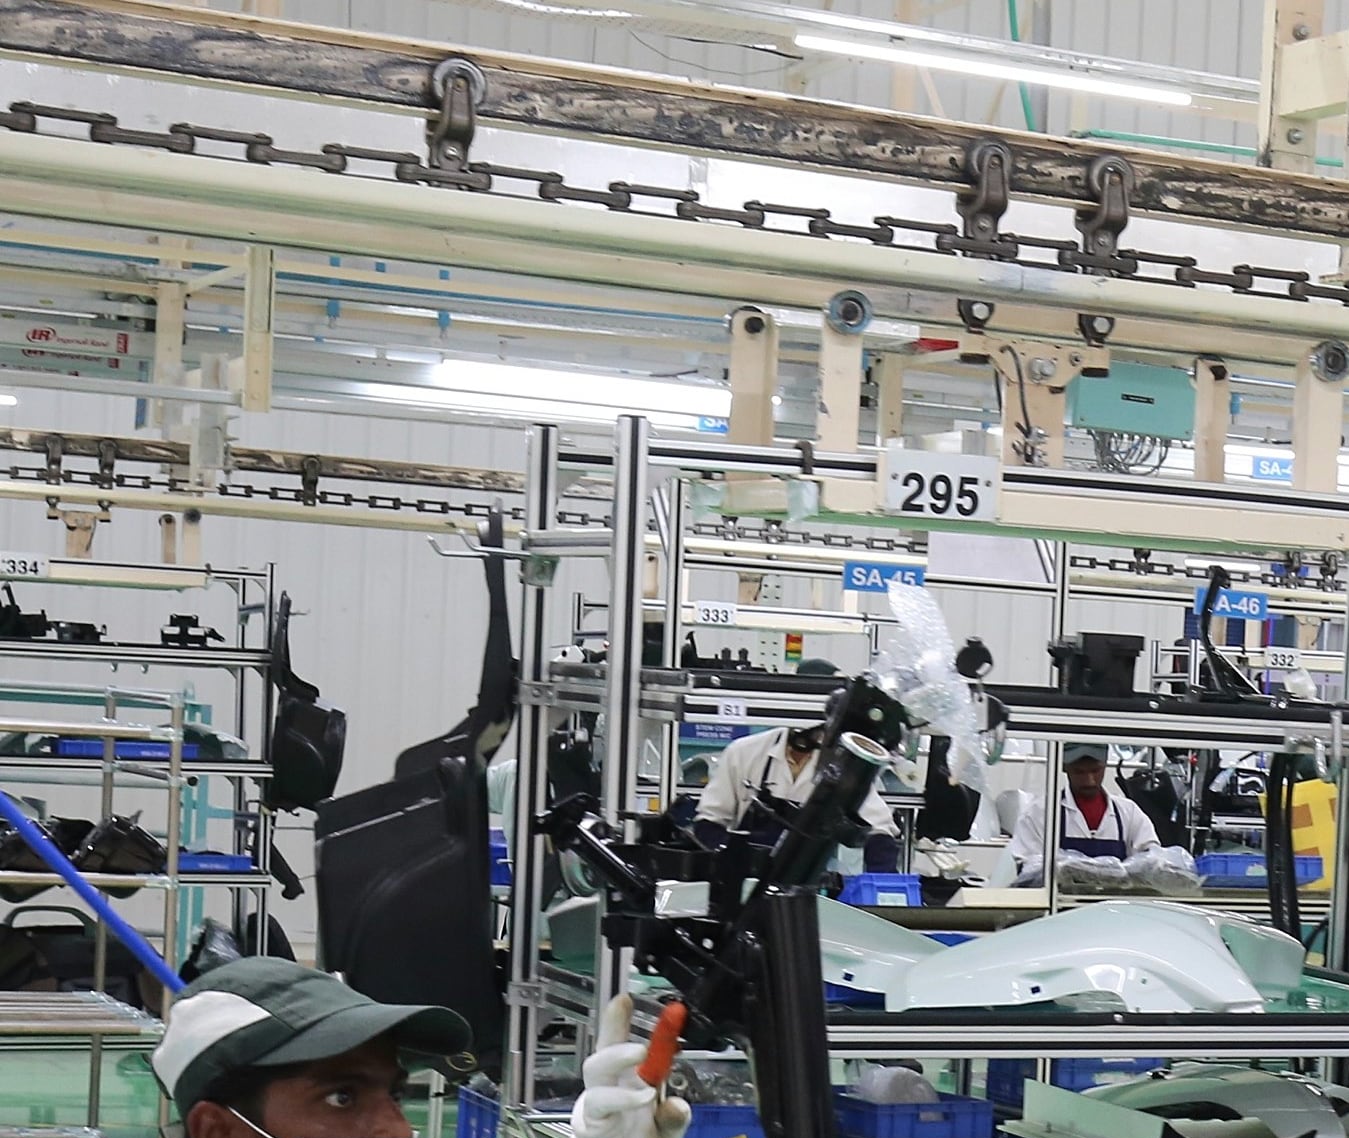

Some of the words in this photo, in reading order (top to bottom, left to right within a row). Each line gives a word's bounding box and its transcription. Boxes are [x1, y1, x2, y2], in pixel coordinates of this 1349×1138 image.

[901, 472, 979, 516] 295
[6, 559, 39, 576] 334
[1215, 594, 1261, 616] A-46
[702, 608, 729, 623] 333
[1271, 653, 1296, 667] 332
